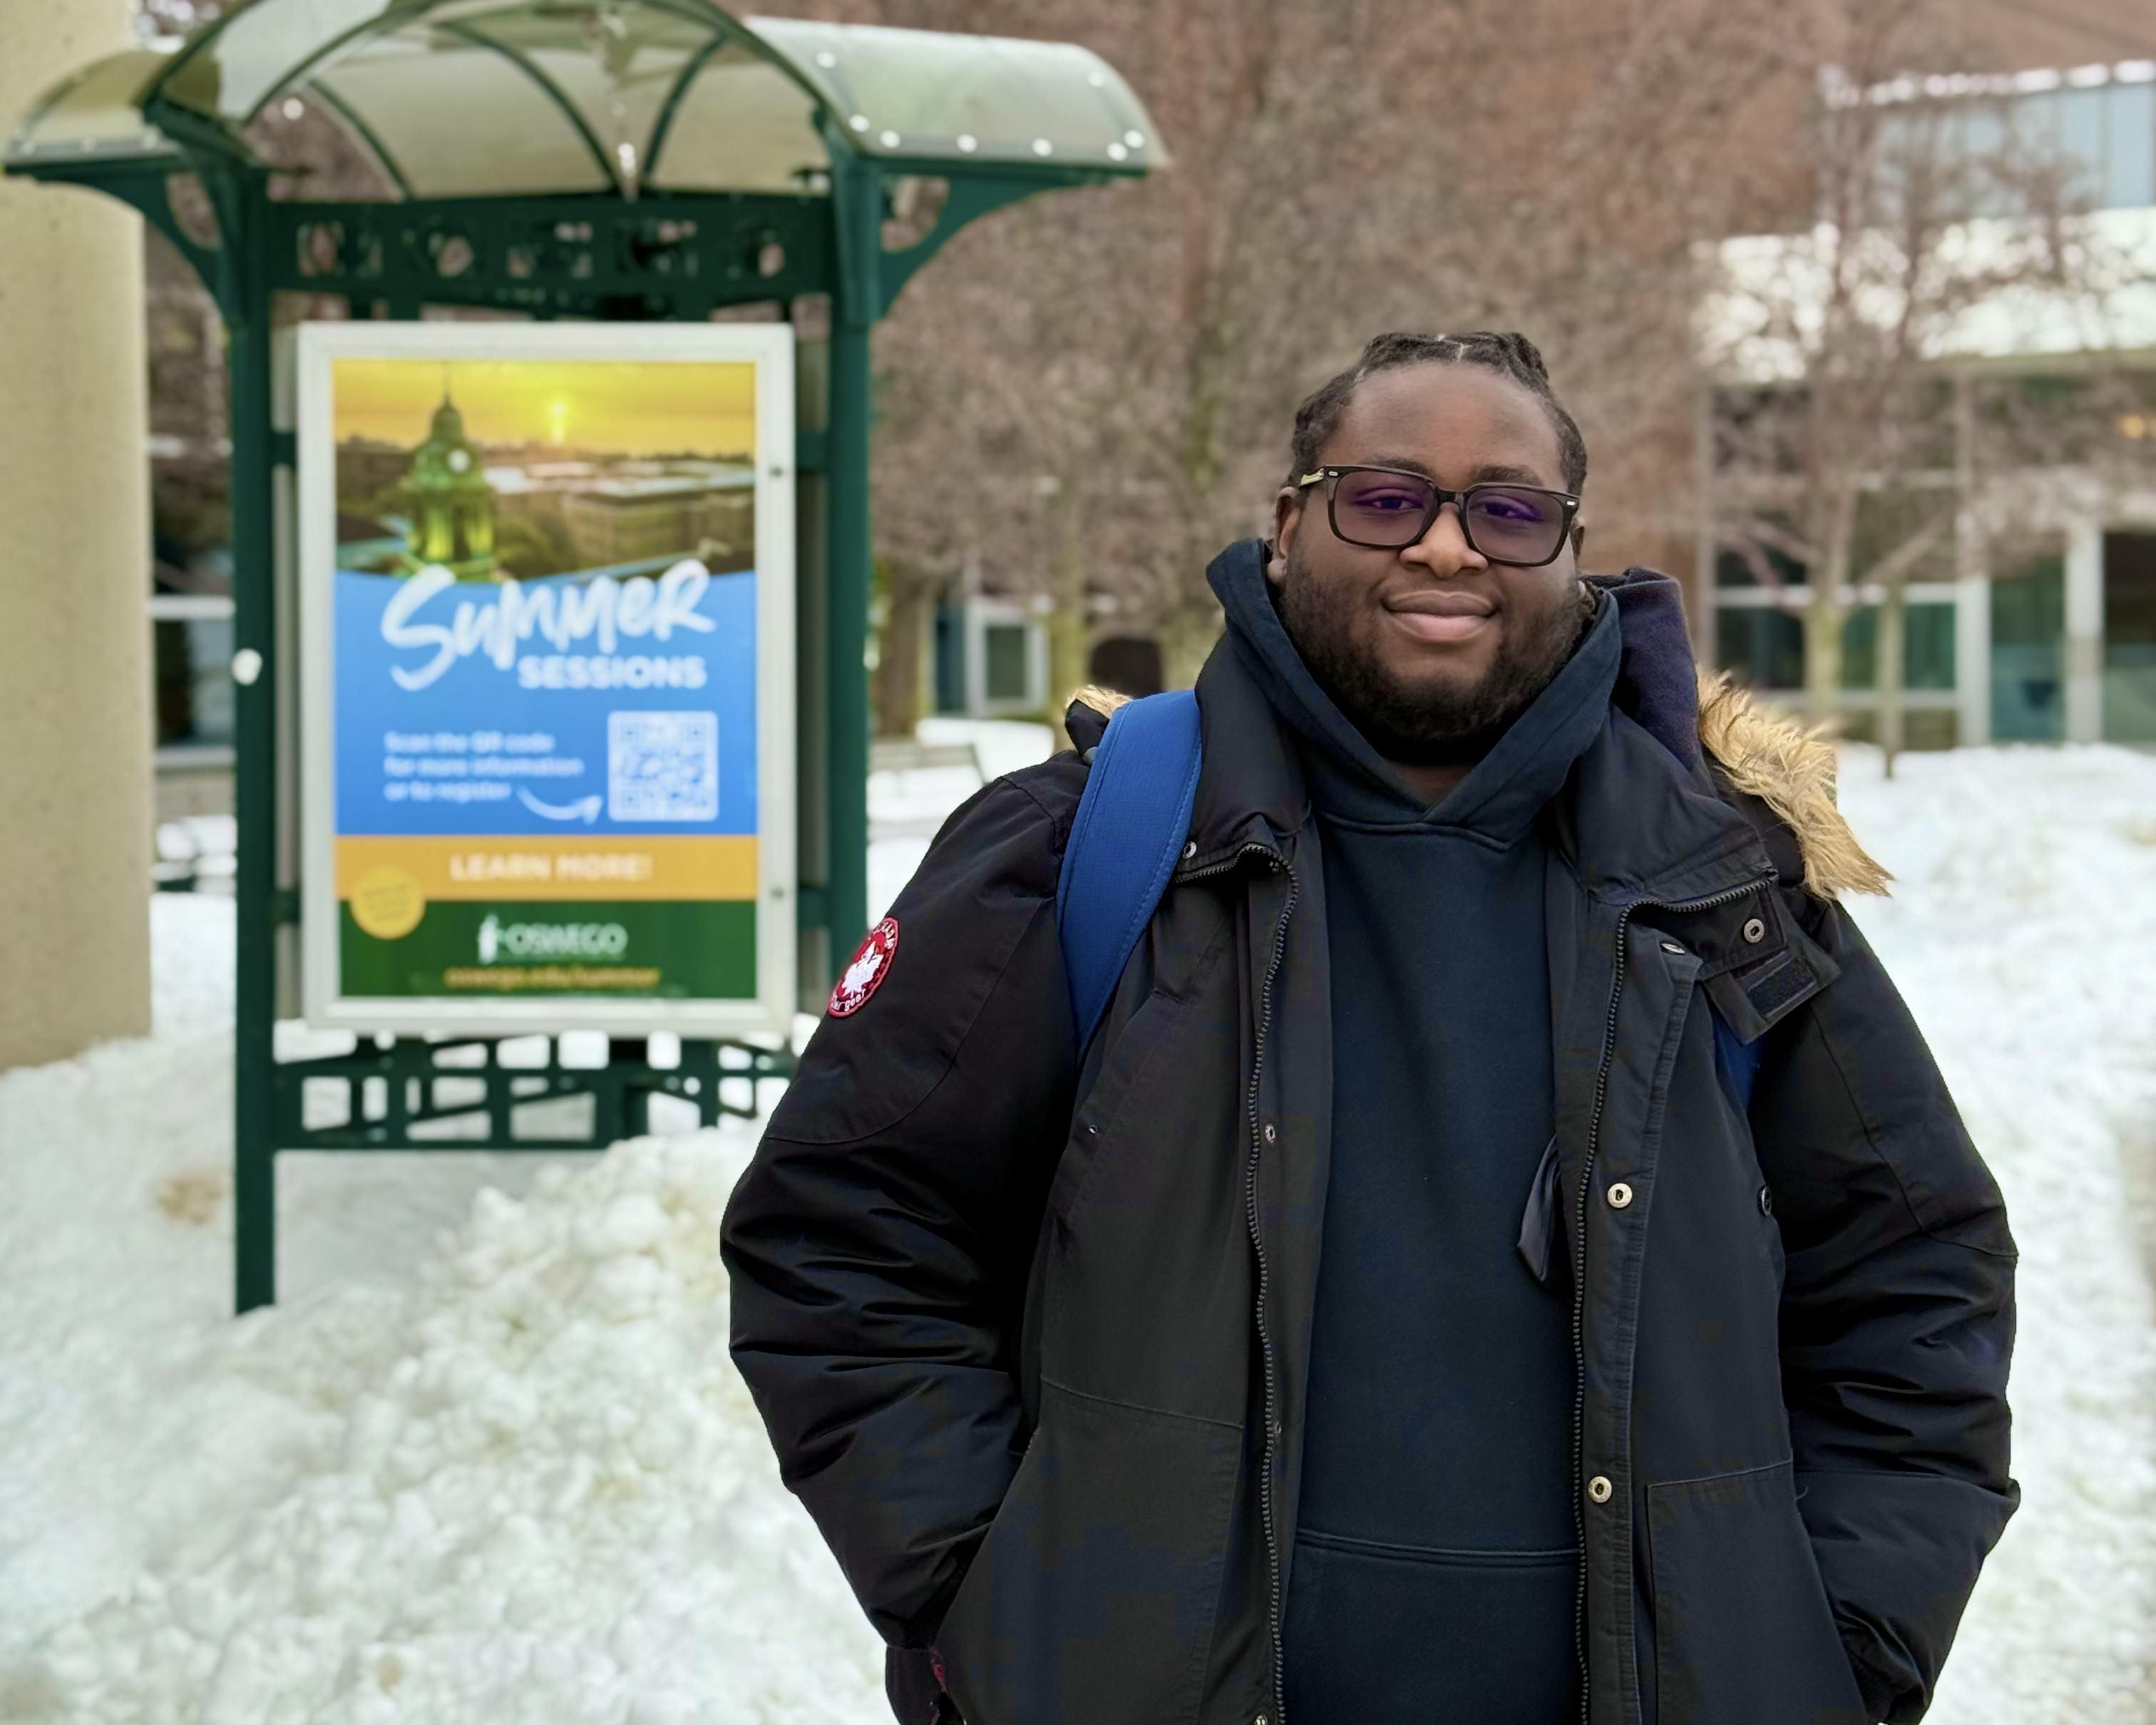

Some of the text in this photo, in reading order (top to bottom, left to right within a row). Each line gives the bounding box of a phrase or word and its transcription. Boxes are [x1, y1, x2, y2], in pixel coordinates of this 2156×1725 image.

[518, 655, 707, 689] SESSIONS
[433, 732, 468, 753] the
[472, 731, 503, 754] QR
[449, 853, 653, 881] LEARN MORE!
[505, 923, 627, 955] OSWEGO
